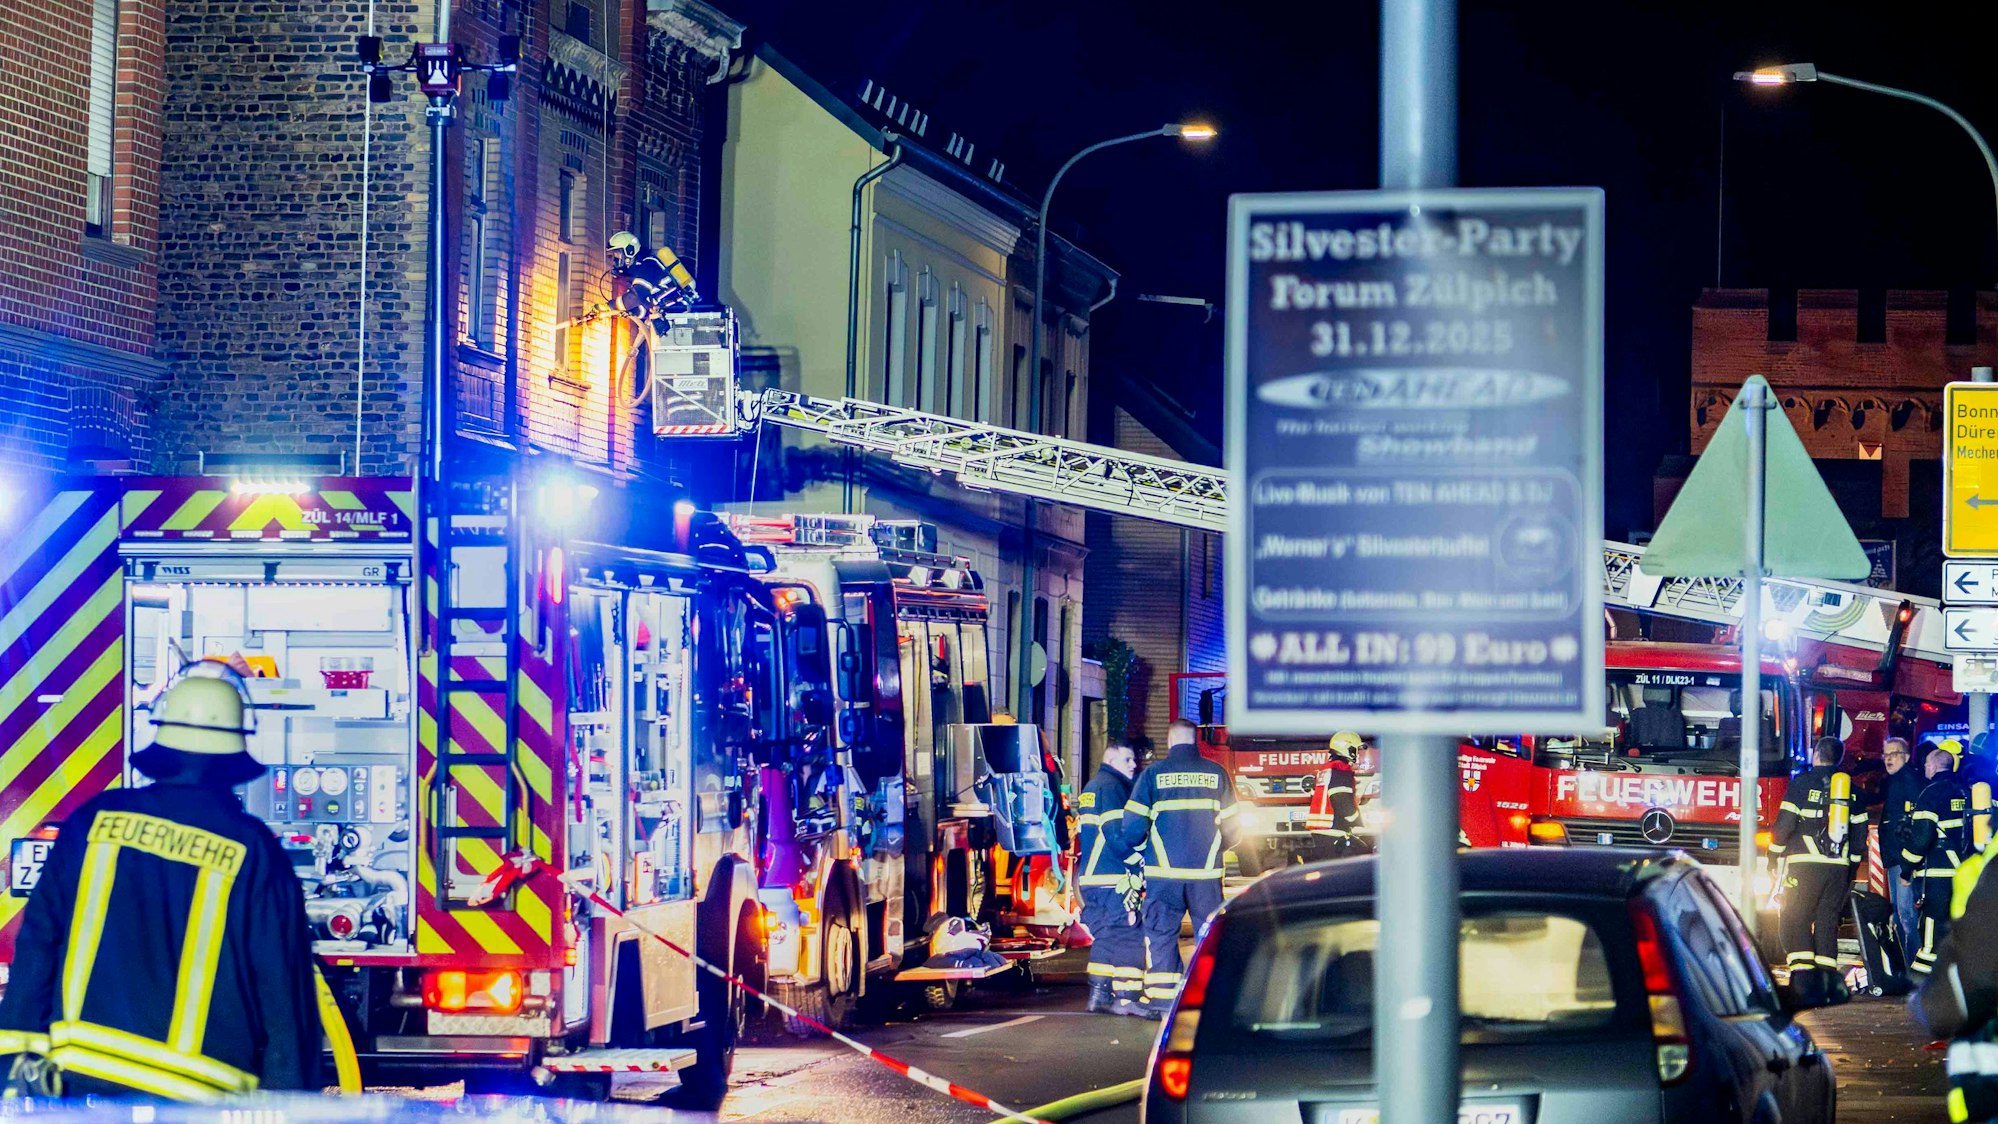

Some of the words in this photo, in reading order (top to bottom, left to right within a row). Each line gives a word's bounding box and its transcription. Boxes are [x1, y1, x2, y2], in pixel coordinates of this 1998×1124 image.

[1250, 219, 1583, 265] Silvester-Party
[1270, 275, 1397, 309] Forum
[1405, 271, 1558, 312] Zülpich
[1311, 321, 1513, 356] 31.12.2025
[1958, 404, 1998, 418] Bonn
[1958, 424, 1998, 438] Düre
[1957, 445, 1998, 459] Meche
[302, 508, 331, 524] ZÜL
[335, 511, 387, 525] 14/MLF
[391, 513, 398, 525] 1
[363, 567, 380, 577] GR
[1278, 632, 1349, 664] ALL
[1355, 633, 1410, 664] IN:
[1416, 633, 1456, 664] 99
[1464, 633, 1547, 664] Euro
[1635, 673, 1650, 684] ZÜL
[1652, 675, 1660, 684] 11
[1665, 675, 1694, 685] DLK23-1
[1259, 753, 1333, 765] FEUERW
[1159, 774, 1215, 786] FEUERWEHR
[98, 815, 238, 872] FEUERWEHR
